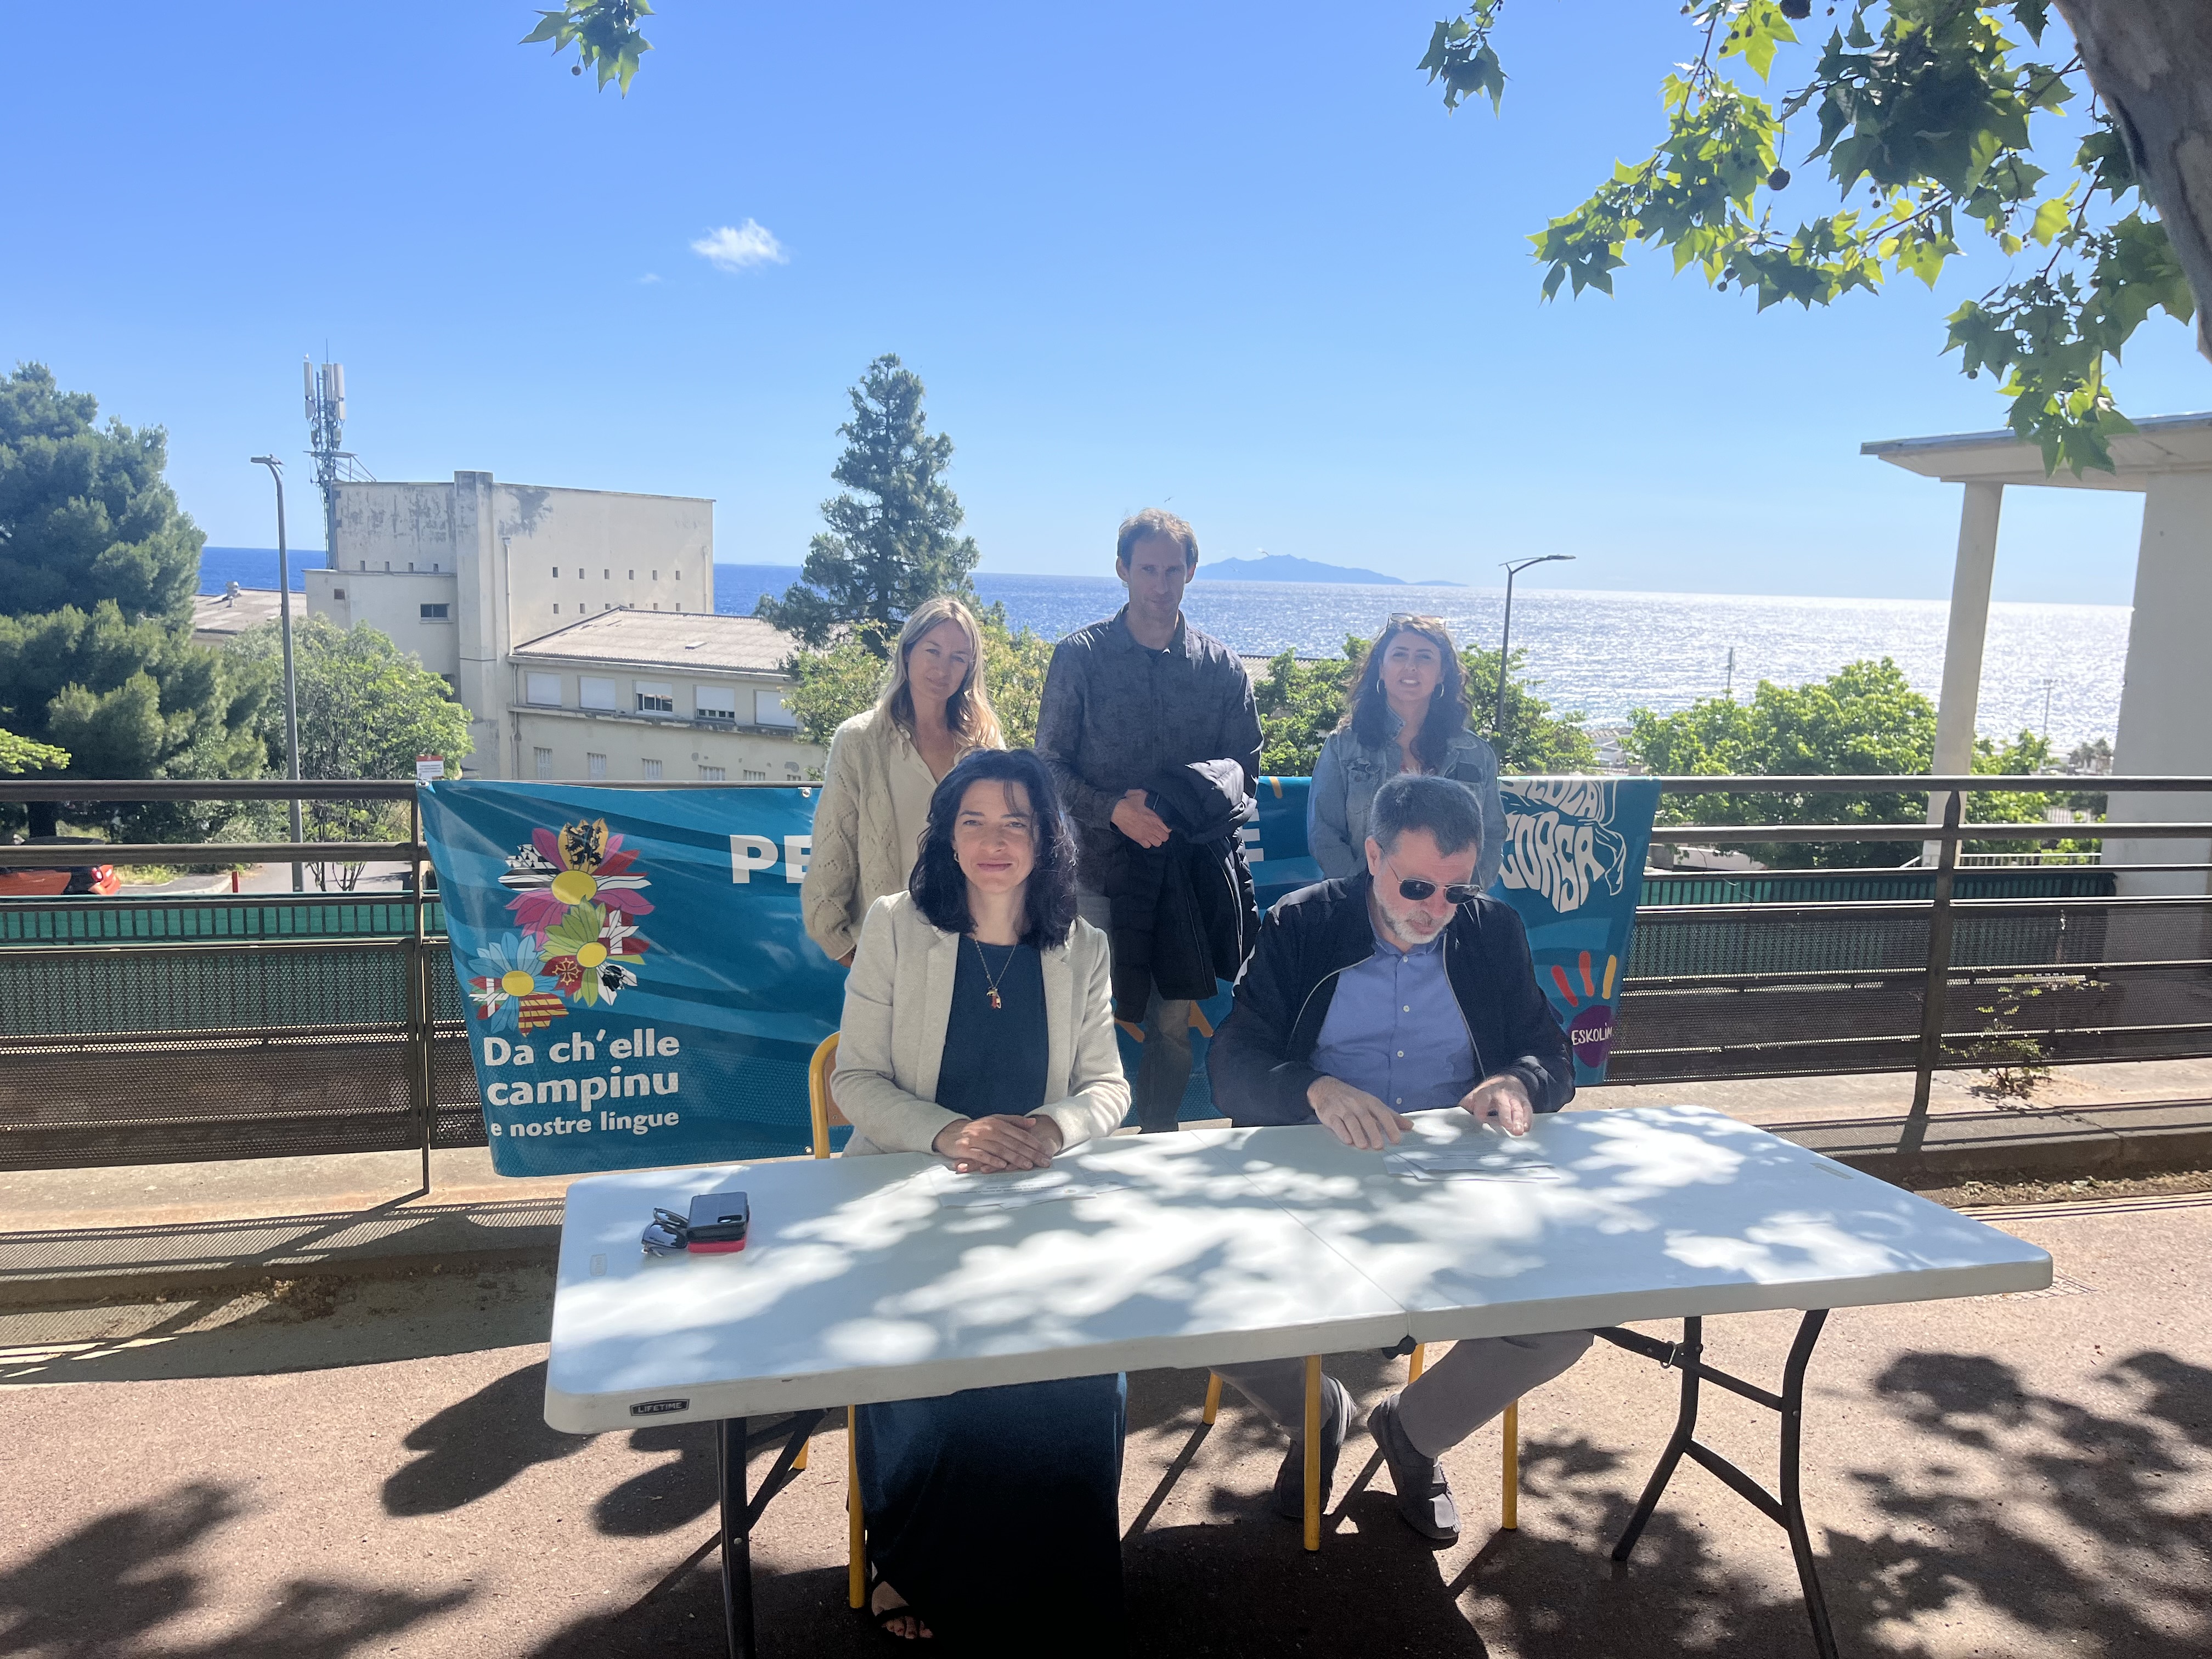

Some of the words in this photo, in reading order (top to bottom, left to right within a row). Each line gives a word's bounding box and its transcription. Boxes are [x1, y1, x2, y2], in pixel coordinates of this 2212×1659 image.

[1498, 811, 1605, 913] CORSA
[483, 1037, 534, 1066] Da
[549, 1028, 680, 1063] ch'elle
[487, 1065, 679, 1112] campinu
[490, 1122, 502, 1136] e
[510, 1116, 591, 1137] nostre
[600, 1111, 679, 1135] lingue
[637, 1402, 682, 1413] LIFETIME
